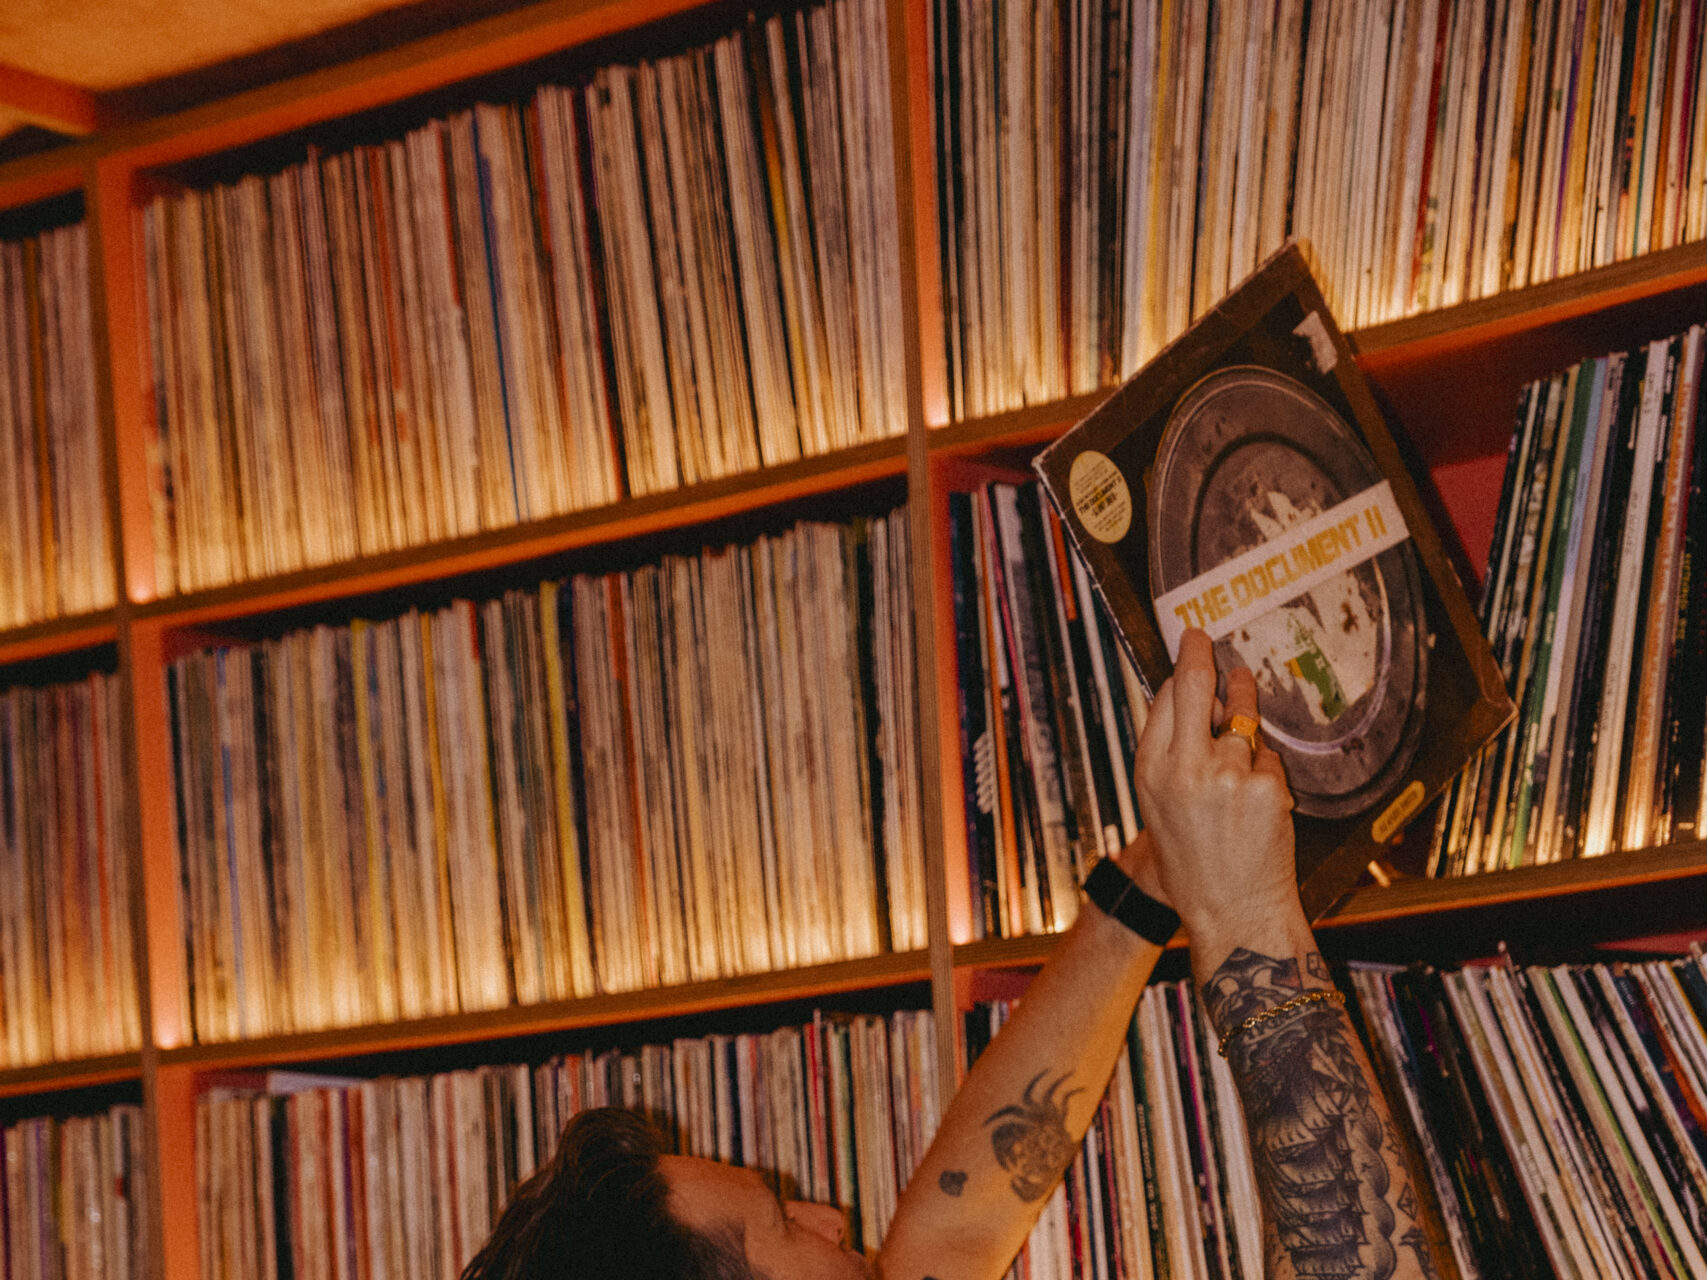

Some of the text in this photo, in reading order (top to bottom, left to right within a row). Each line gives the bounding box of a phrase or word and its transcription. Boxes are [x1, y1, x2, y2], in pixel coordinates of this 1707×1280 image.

[1174, 505, 1388, 629] THE DOCUMENT II
